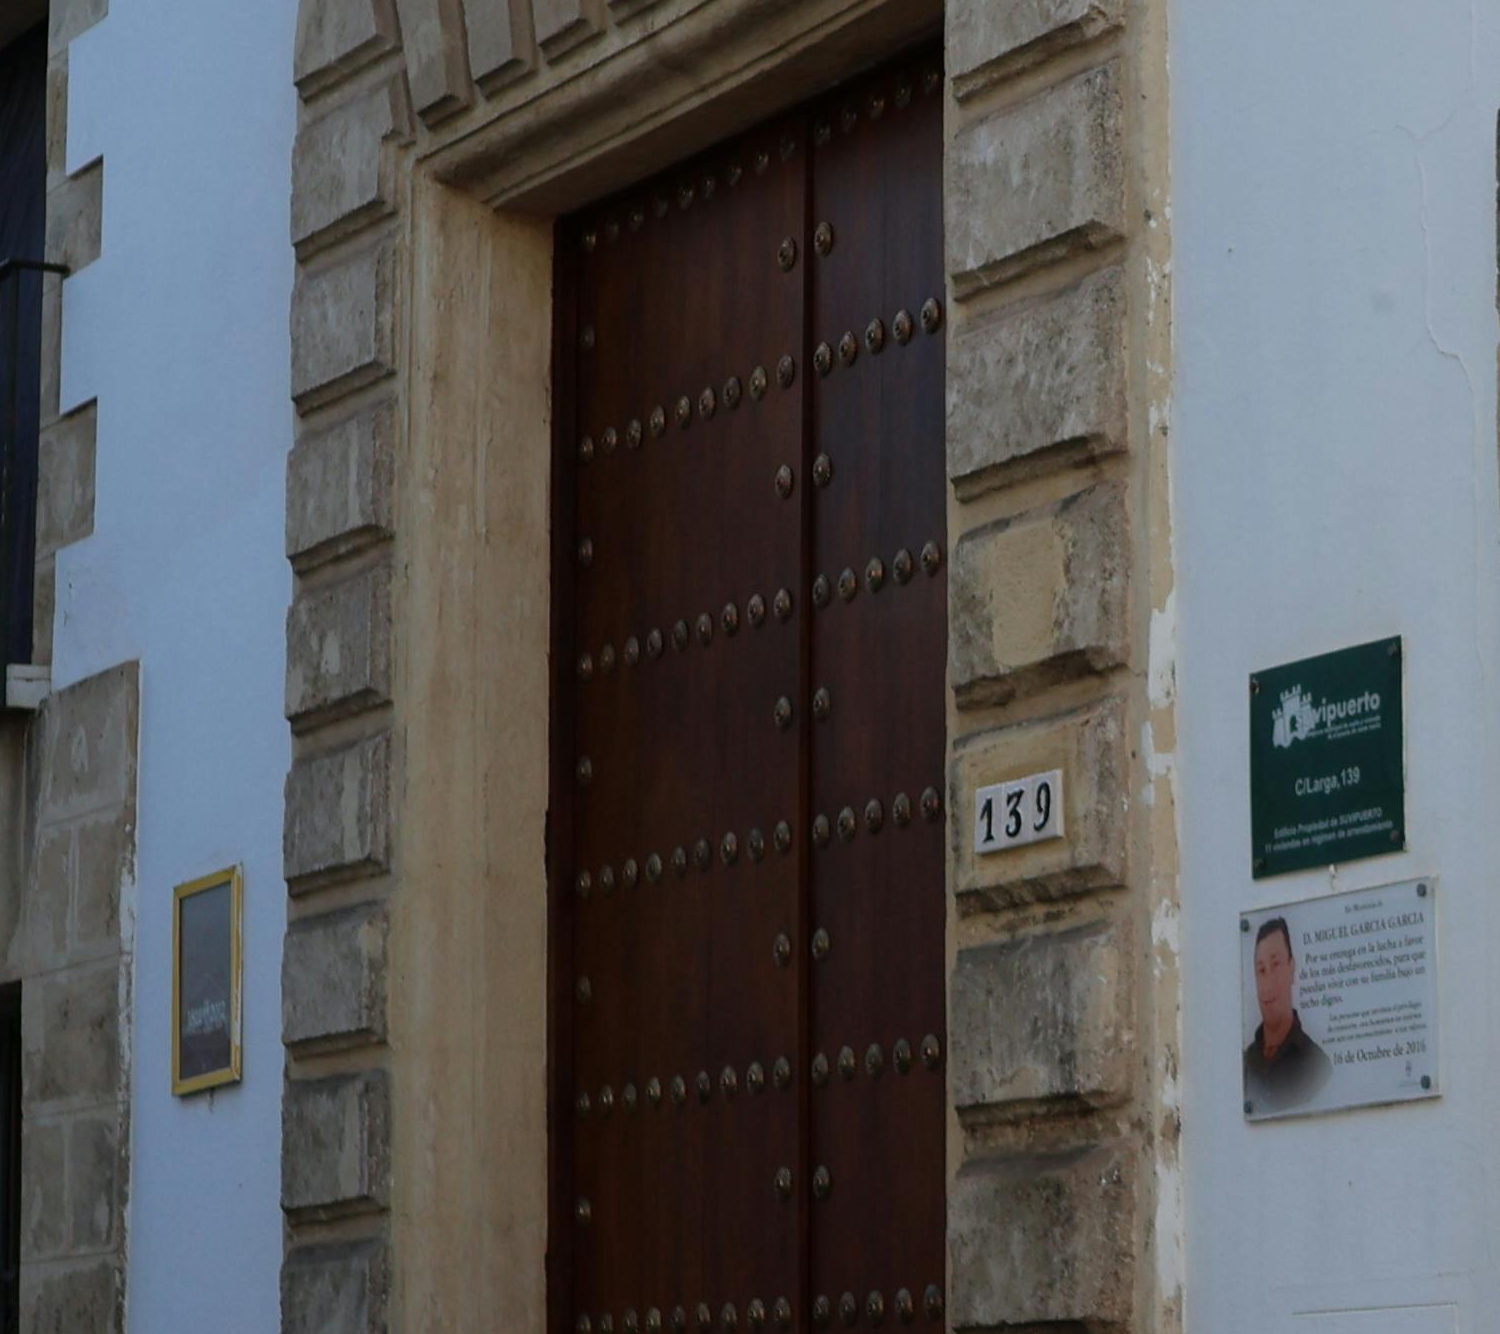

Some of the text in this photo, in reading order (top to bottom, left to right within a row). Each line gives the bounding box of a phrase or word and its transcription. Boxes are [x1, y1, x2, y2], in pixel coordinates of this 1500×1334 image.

[980, 782, 1051, 844] 139
[1314, 925, 1349, 942] MIGUEL
[1376, 937, 1397, 952] lucha
[1344, 1049, 1355, 1063] de
[1356, 1044, 1392, 1062] Octubre
[1393, 1042, 1404, 1056] de
